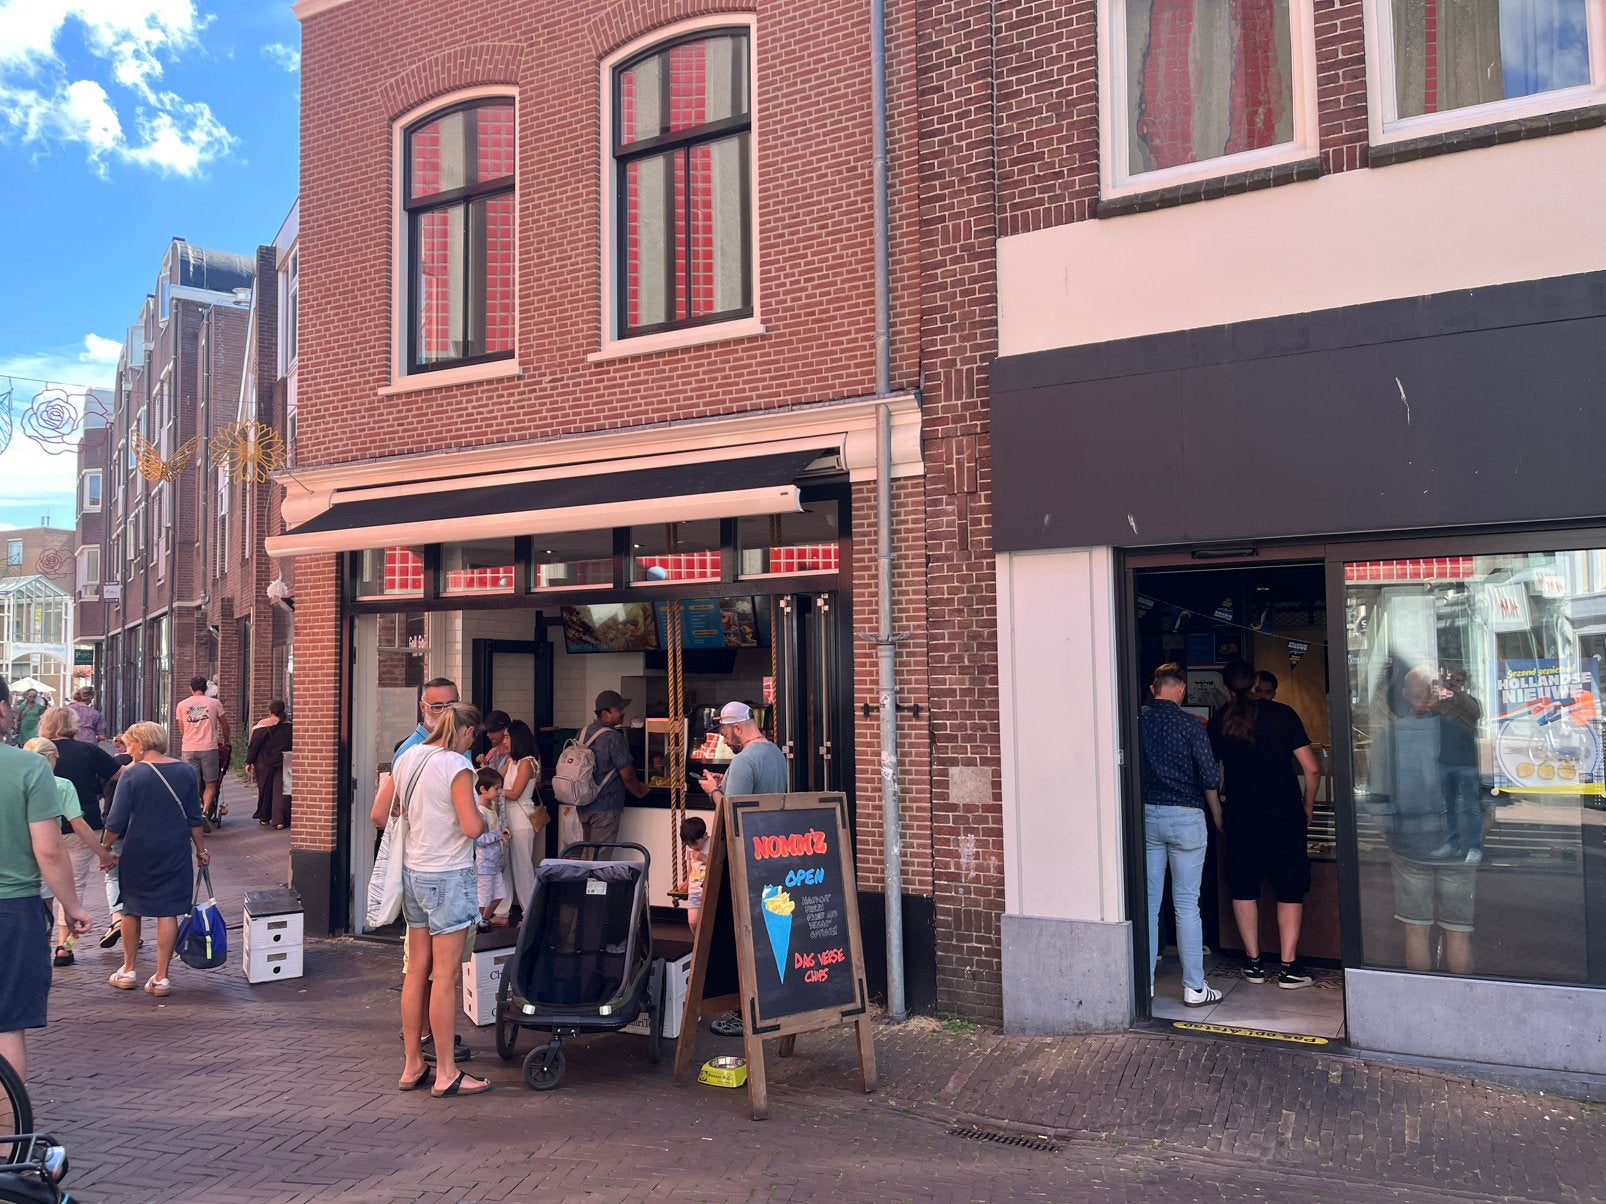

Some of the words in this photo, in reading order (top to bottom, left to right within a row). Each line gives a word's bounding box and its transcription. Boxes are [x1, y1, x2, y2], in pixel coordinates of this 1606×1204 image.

[1497, 671, 1592, 691] HOLLANDSE
[1507, 667, 1537, 679] Gezond
[1502, 684, 1583, 704] NIEUWE
[753, 828, 828, 860] NOMM'Z
[784, 867, 825, 888] OPEN
[794, 952, 816, 970] DAG
[817, 947, 846, 966] VERSE
[804, 967, 829, 983] CHIPS
[1183, 1022, 1242, 1034] Afstap
